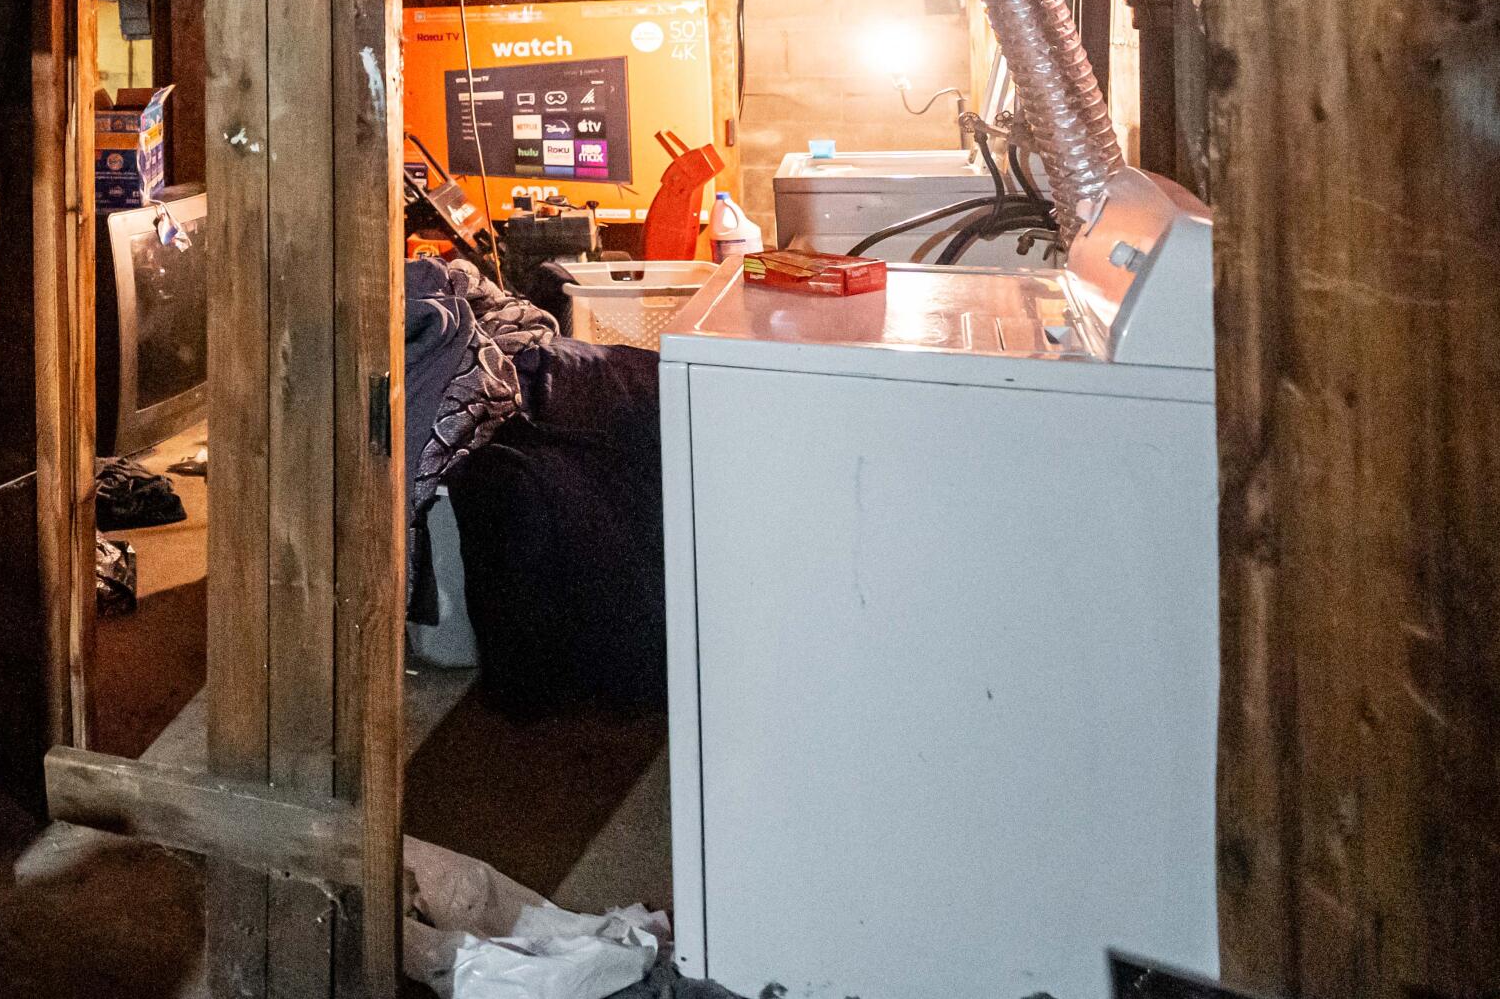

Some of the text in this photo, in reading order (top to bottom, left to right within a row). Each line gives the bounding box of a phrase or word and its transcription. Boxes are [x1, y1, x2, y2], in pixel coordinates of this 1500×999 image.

[447, 32, 460, 41] TV
[492, 35, 573, 57] watch
[670, 43, 697, 60] 4K
[517, 147, 539, 157] hulu
[579, 153, 605, 163] max
